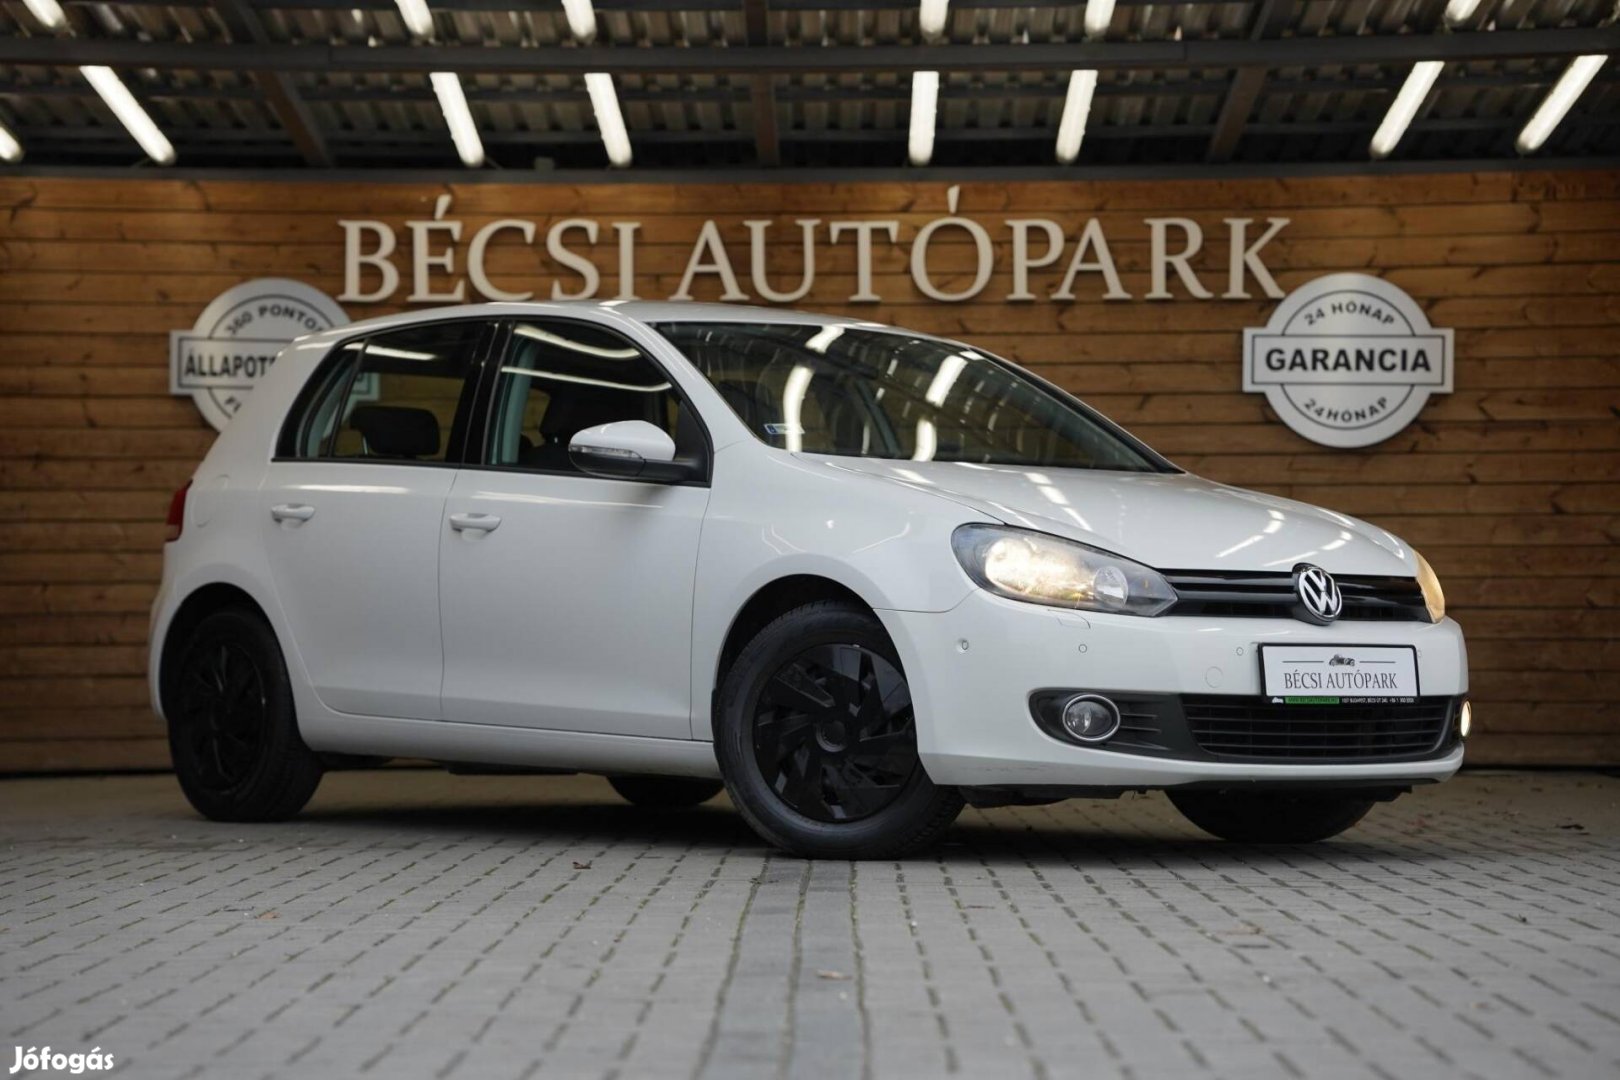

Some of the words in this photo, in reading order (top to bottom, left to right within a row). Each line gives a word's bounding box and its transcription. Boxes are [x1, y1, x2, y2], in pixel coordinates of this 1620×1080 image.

[338, 194, 642, 302] BÉCSI
[668, 185, 1291, 302] AUTÓPARK
[1304, 307, 1325, 326] 24
[1266, 348, 1431, 372] GARANCIA
[1284, 669, 1322, 689] BÉCSI
[1327, 669, 1398, 689] AUTÓPARK
